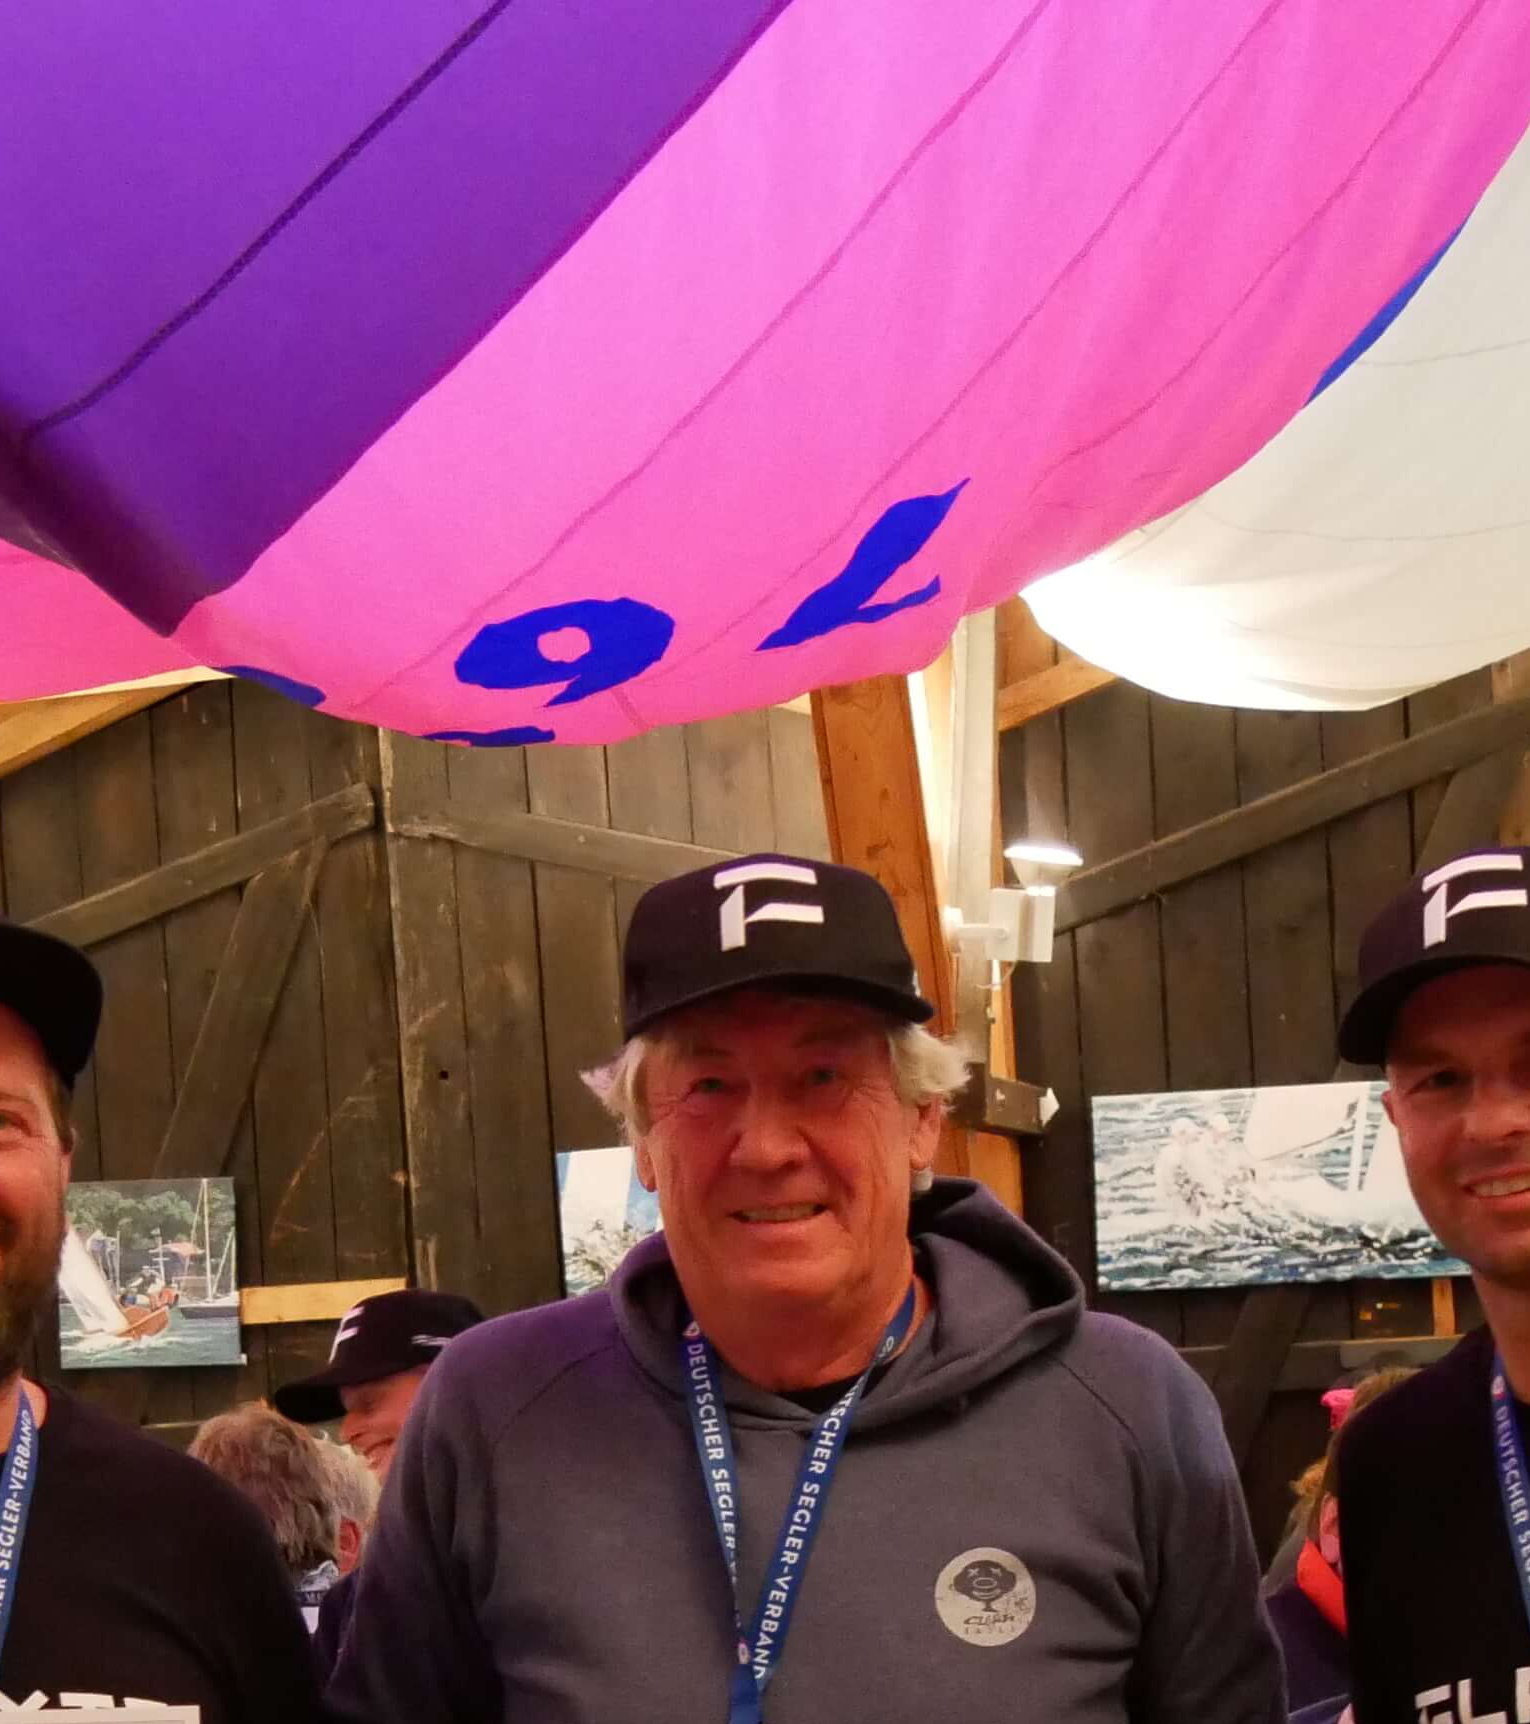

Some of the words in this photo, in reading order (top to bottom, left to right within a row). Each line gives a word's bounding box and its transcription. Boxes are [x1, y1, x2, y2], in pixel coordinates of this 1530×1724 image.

[713, 862, 826, 953] F
[1421, 853, 1529, 951] F
[686, 1343, 726, 1462] DEUTSCHER
[1493, 1405, 1528, 1523] DEUTSCHER
